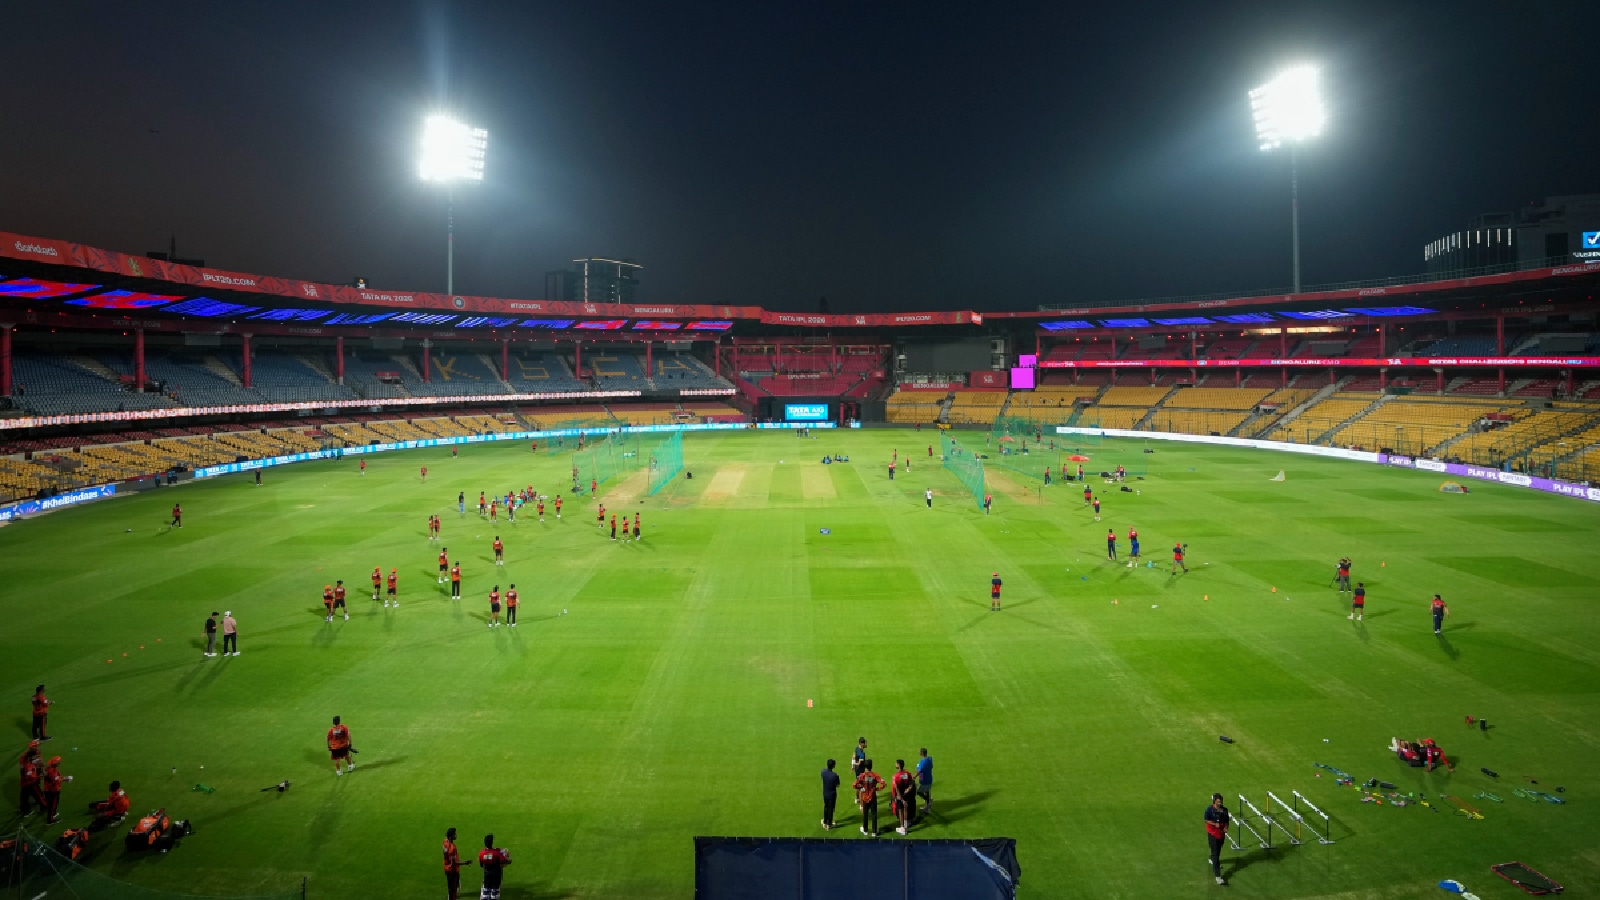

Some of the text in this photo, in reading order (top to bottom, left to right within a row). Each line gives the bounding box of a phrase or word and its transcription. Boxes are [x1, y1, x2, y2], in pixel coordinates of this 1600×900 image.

[202, 273, 255, 286] IPLT20.COM
[361, 293, 380, 301] TATA
[788, 406, 809, 414] TATA
[1467, 469, 1498, 480] PLAY IPL
[1552, 483, 1573, 493] PLAY
[1573, 486, 1586, 496] IPL
